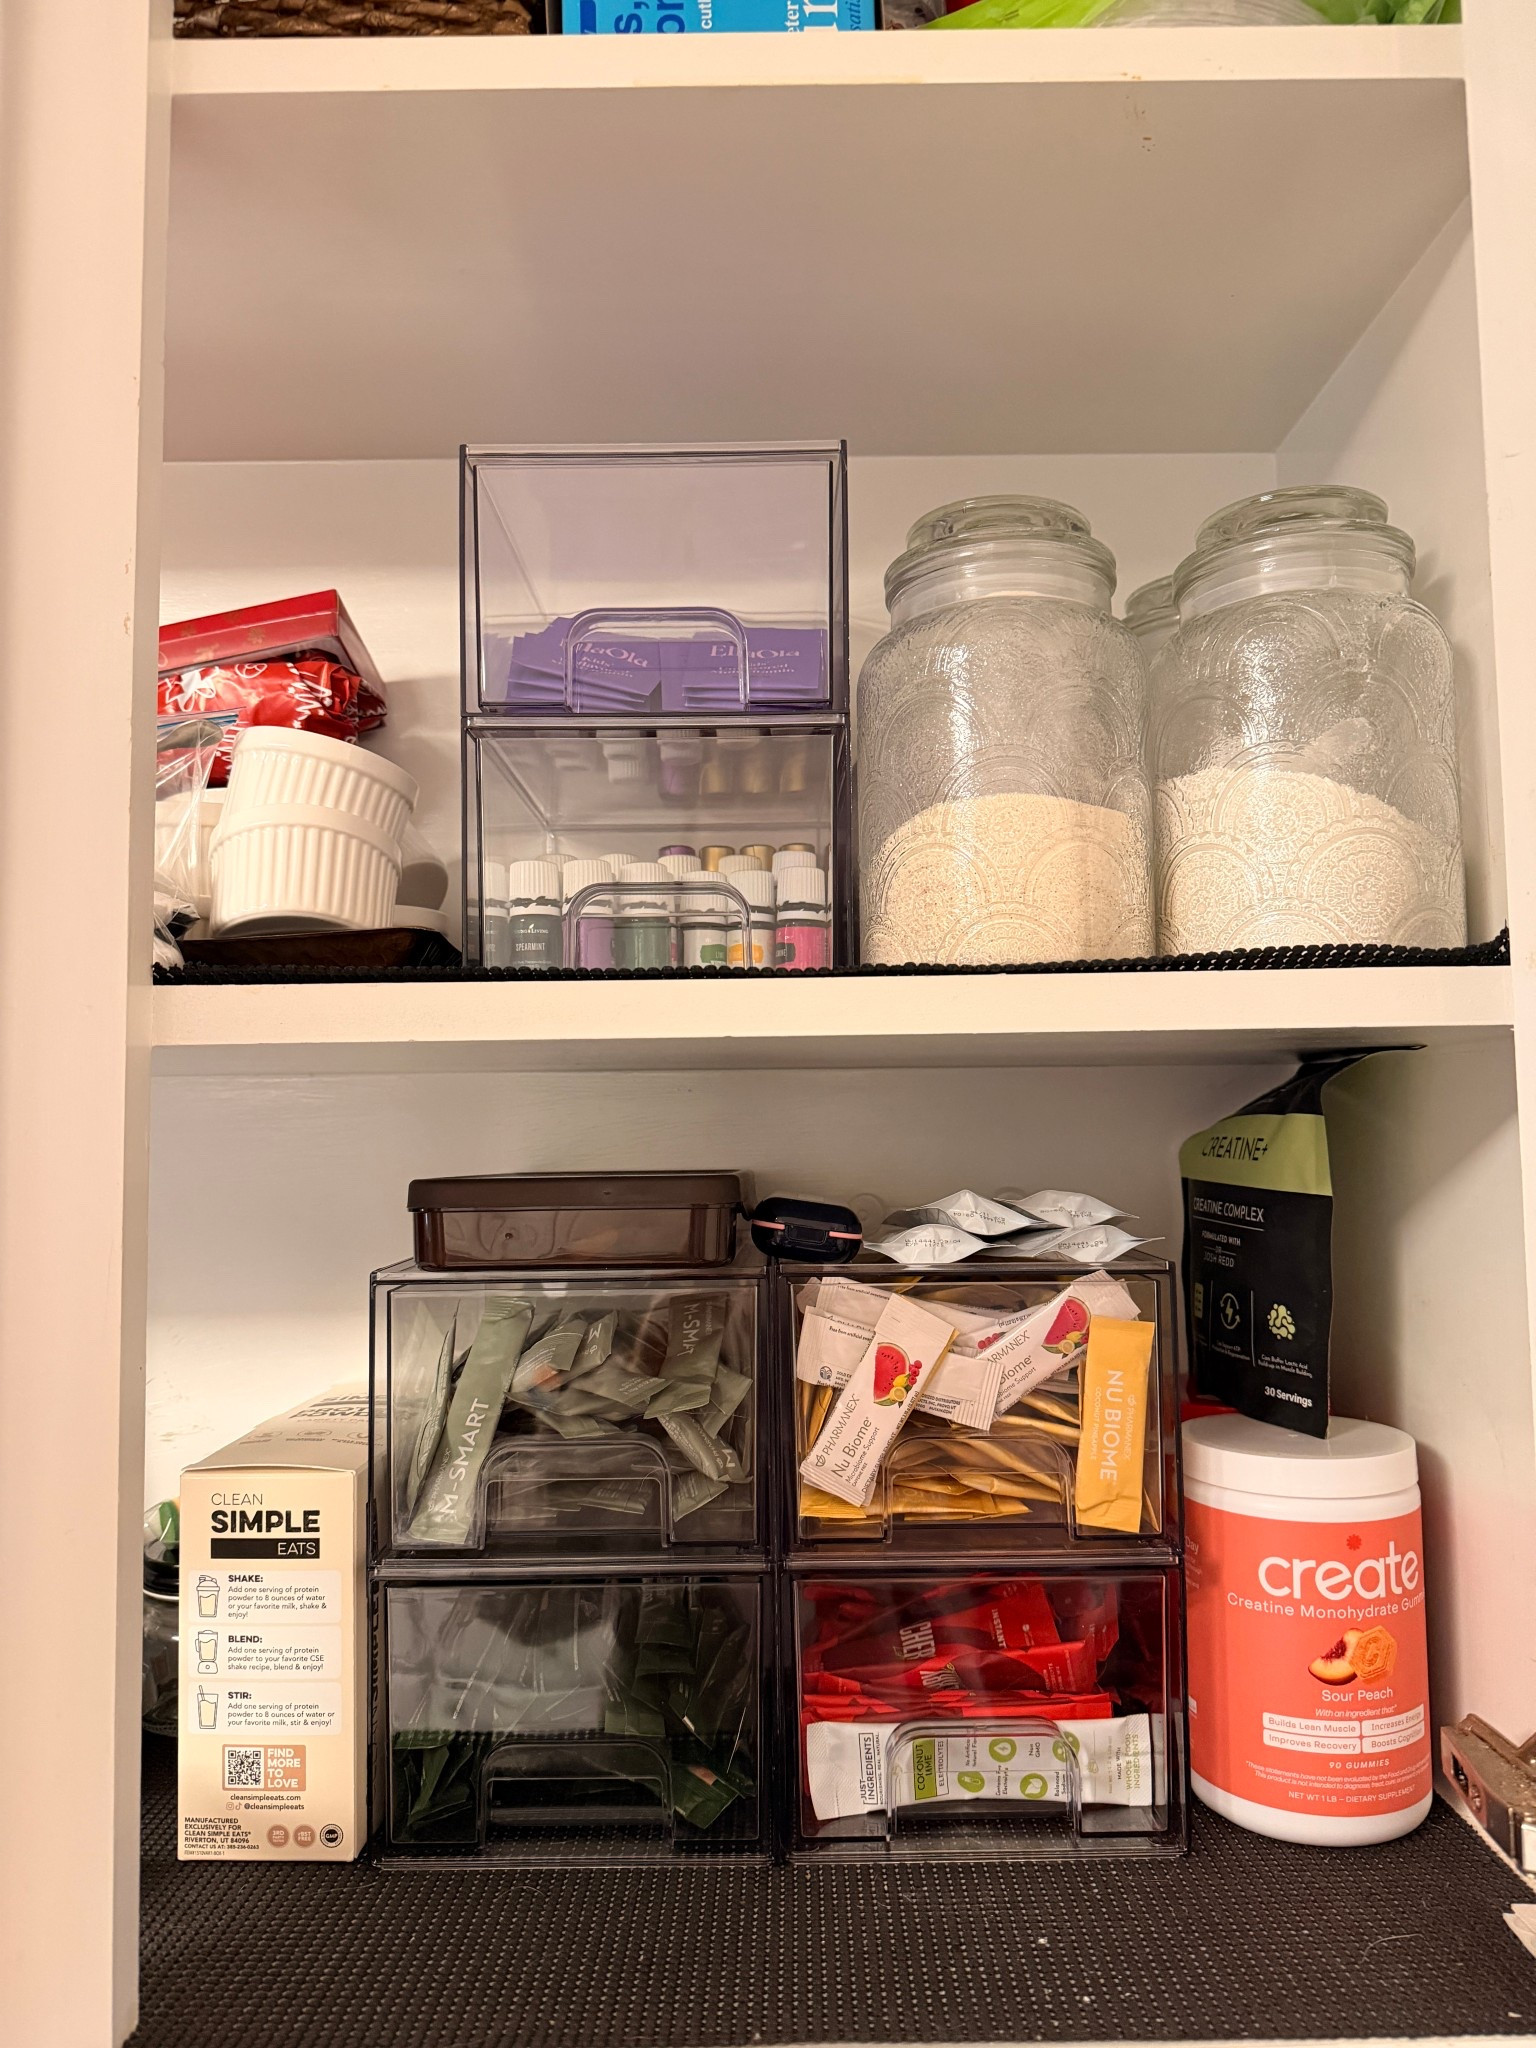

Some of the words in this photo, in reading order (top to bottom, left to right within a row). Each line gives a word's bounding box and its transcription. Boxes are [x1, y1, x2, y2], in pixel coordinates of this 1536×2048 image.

[1202, 1136, 1268, 1161] CREATINE+
[1193, 1197, 1223, 1215] CREATINE
[1223, 1202, 1265, 1223] COMPLEX
[1228, 1237, 1241, 1246] WITH
[1218, 1256, 1235, 1268] REDD
[1299, 1362, 1308, 1370] Acid
[1015, 1366, 1037, 1384] Support
[1106, 1370, 1124, 1403] NU
[1264, 1386, 1275, 1397] 30
[1276, 1388, 1313, 1408] Servings
[823, 1393, 859, 1456] PHARMANEX
[1124, 1407, 1137, 1460] PHARMANEX
[831, 1459, 851, 1478] Nu
[842, 1418, 872, 1459] Biome
[1100, 1409, 1122, 1481] BIOME
[440, 1398, 489, 1515] M-SMART
[845, 1450, 868, 1484] Microbiome
[865, 1427, 880, 1452] Support
[211, 1493, 263, 1505] CLEAN
[211, 1510, 320, 1533] SIMPLE
[277, 1542, 316, 1555] EATS
[228, 1575, 263, 1583] SHAKE:
[1258, 1541, 1419, 1601] create
[259, 1586, 283, 1594] serving
[294, 1586, 319, 1594] protein
[1227, 1592, 1294, 1616] Creatine
[1301, 1602, 1398, 1621] Monohydrate
[228, 1611, 248, 1619] enjoy!
[992, 1608, 1008, 1649] INSTANT
[259, 1647, 283, 1655] serving
[294, 1647, 319, 1655] protein
[1322, 1689, 1354, 1702] Sour
[1358, 1686, 1393, 1701] Peach
[259, 1703, 283, 1711] serving
[294, 1703, 319, 1711] protein
[1315, 1708, 1333, 1717] With
[1347, 1707, 1381, 1718] ingredient
[1268, 1717, 1297, 1729] Builds
[1299, 1722, 1322, 1731] Lean
[1324, 1724, 1356, 1733] Muscle
[1372, 1720, 1405, 1731] Increases
[1269, 1734, 1312, 1747] Improves
[1314, 1740, 1357, 1751] Recovery
[1371, 1738, 1397, 1748] Boosts
[267, 1749, 294, 1758] FIND
[1133, 1733, 1141, 1790] INGREDIENTS
[267, 1758, 301, 1768] MORE
[864, 1736, 875, 1800] INGREDIENTS
[1329, 1761, 1342, 1769] 90
[1346, 1758, 1390, 1769] GUMMIES
[267, 1769, 283, 1777] TO
[1255, 1769, 1267, 1778] This
[1267, 1773, 1290, 1784] product
[1309, 1781, 1336, 1789] intended
[1265, 1767, 1299, 1778] statements
[267, 1779, 298, 1788] LOVE
[860, 1779, 868, 1800] JUST
[230, 1794, 301, 1802] cleansimpleeats.com
[1288, 1791, 1304, 1799] NET
[1306, 1793, 1320, 1801] WT
[1346, 1795, 1377, 1803] DIETARY
[1378, 1784, 1415, 1801] SUPPLEMENT
[244, 1803, 305, 1811] @cleansimpleeats
